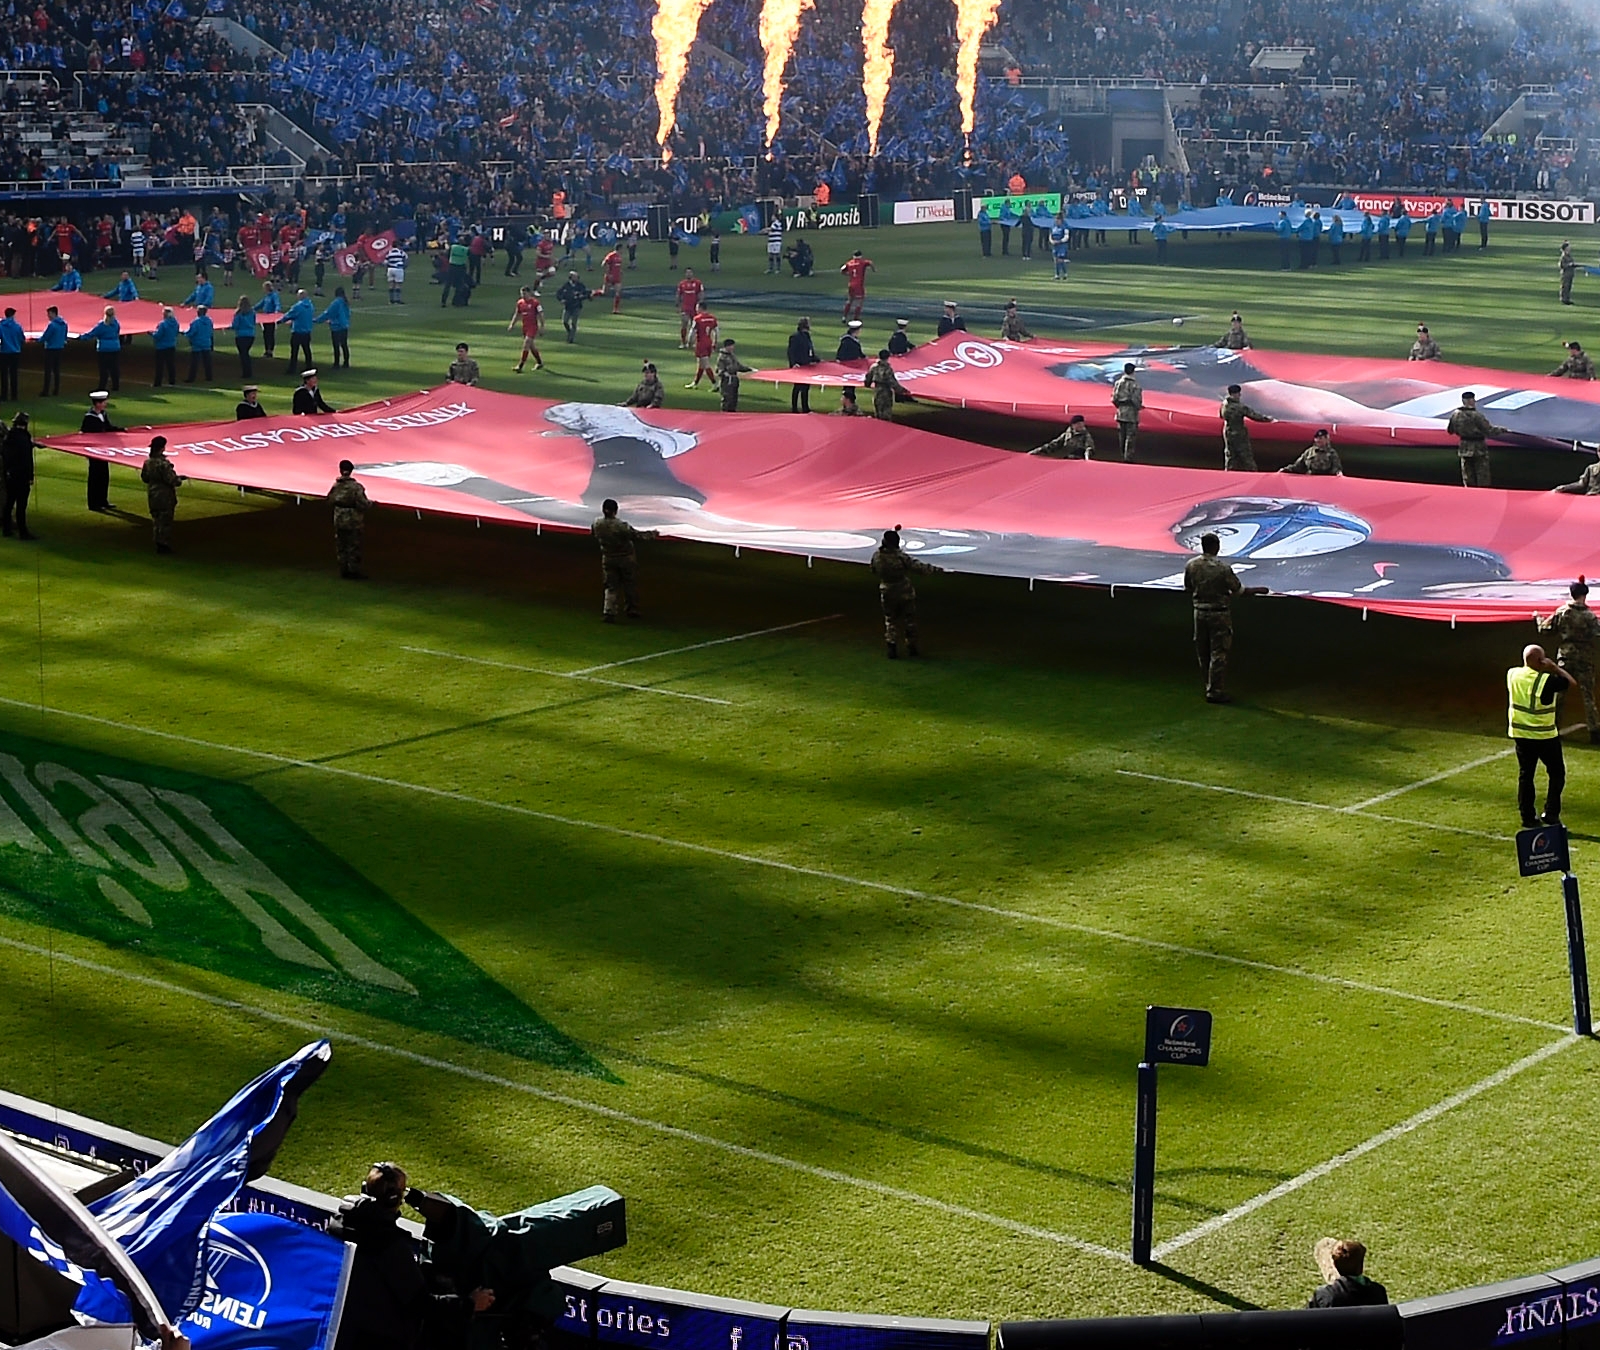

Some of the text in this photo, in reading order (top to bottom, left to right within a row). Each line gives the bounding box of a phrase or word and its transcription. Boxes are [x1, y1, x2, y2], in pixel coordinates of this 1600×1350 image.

[1501, 202, 1590, 222] TISSOT
[173, 421, 379, 454] NEWCASTLE
[563, 1295, 670, 1337] Stories
